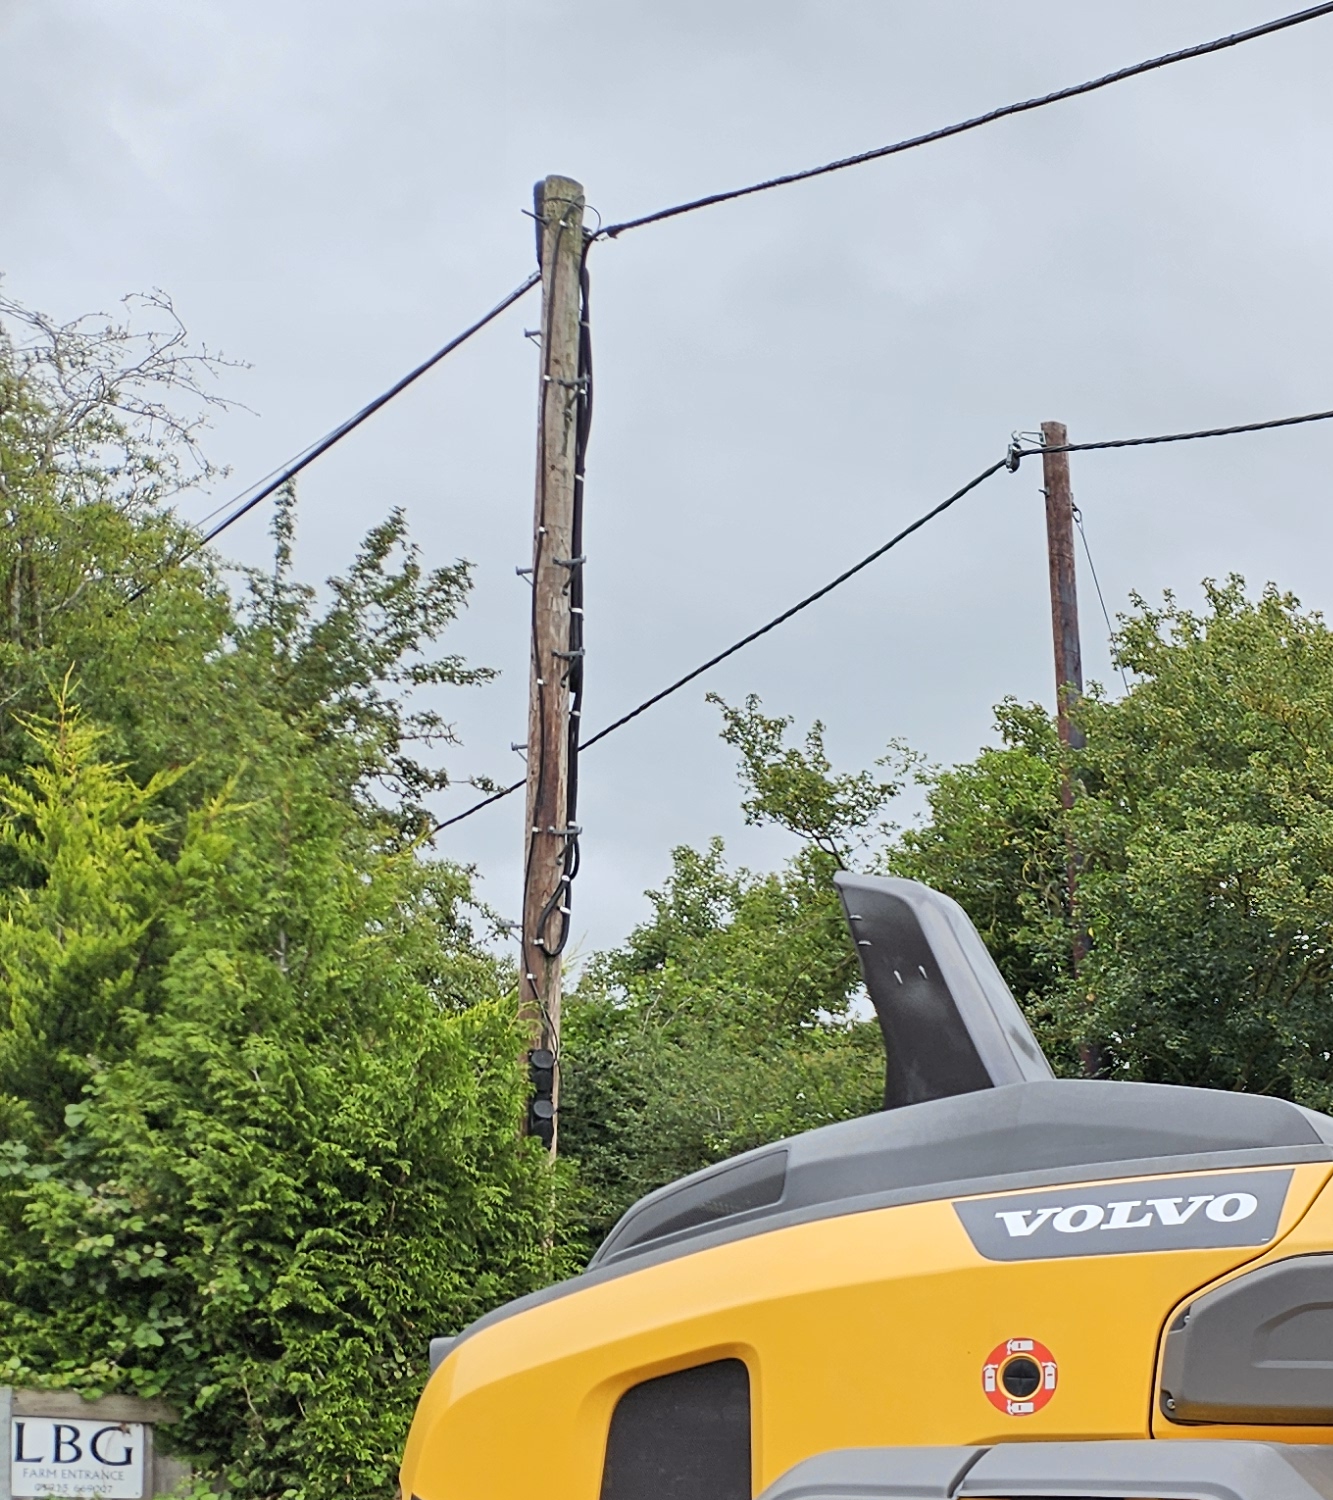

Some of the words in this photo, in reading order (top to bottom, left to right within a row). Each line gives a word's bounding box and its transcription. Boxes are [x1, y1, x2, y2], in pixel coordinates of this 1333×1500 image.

[994, 1192, 1258, 1238] VOLVO
[14, 1421, 134, 1467] LBG
[22, 1467, 57, 1480] FARM
[61, 1468, 126, 1482] ENTRANCE
